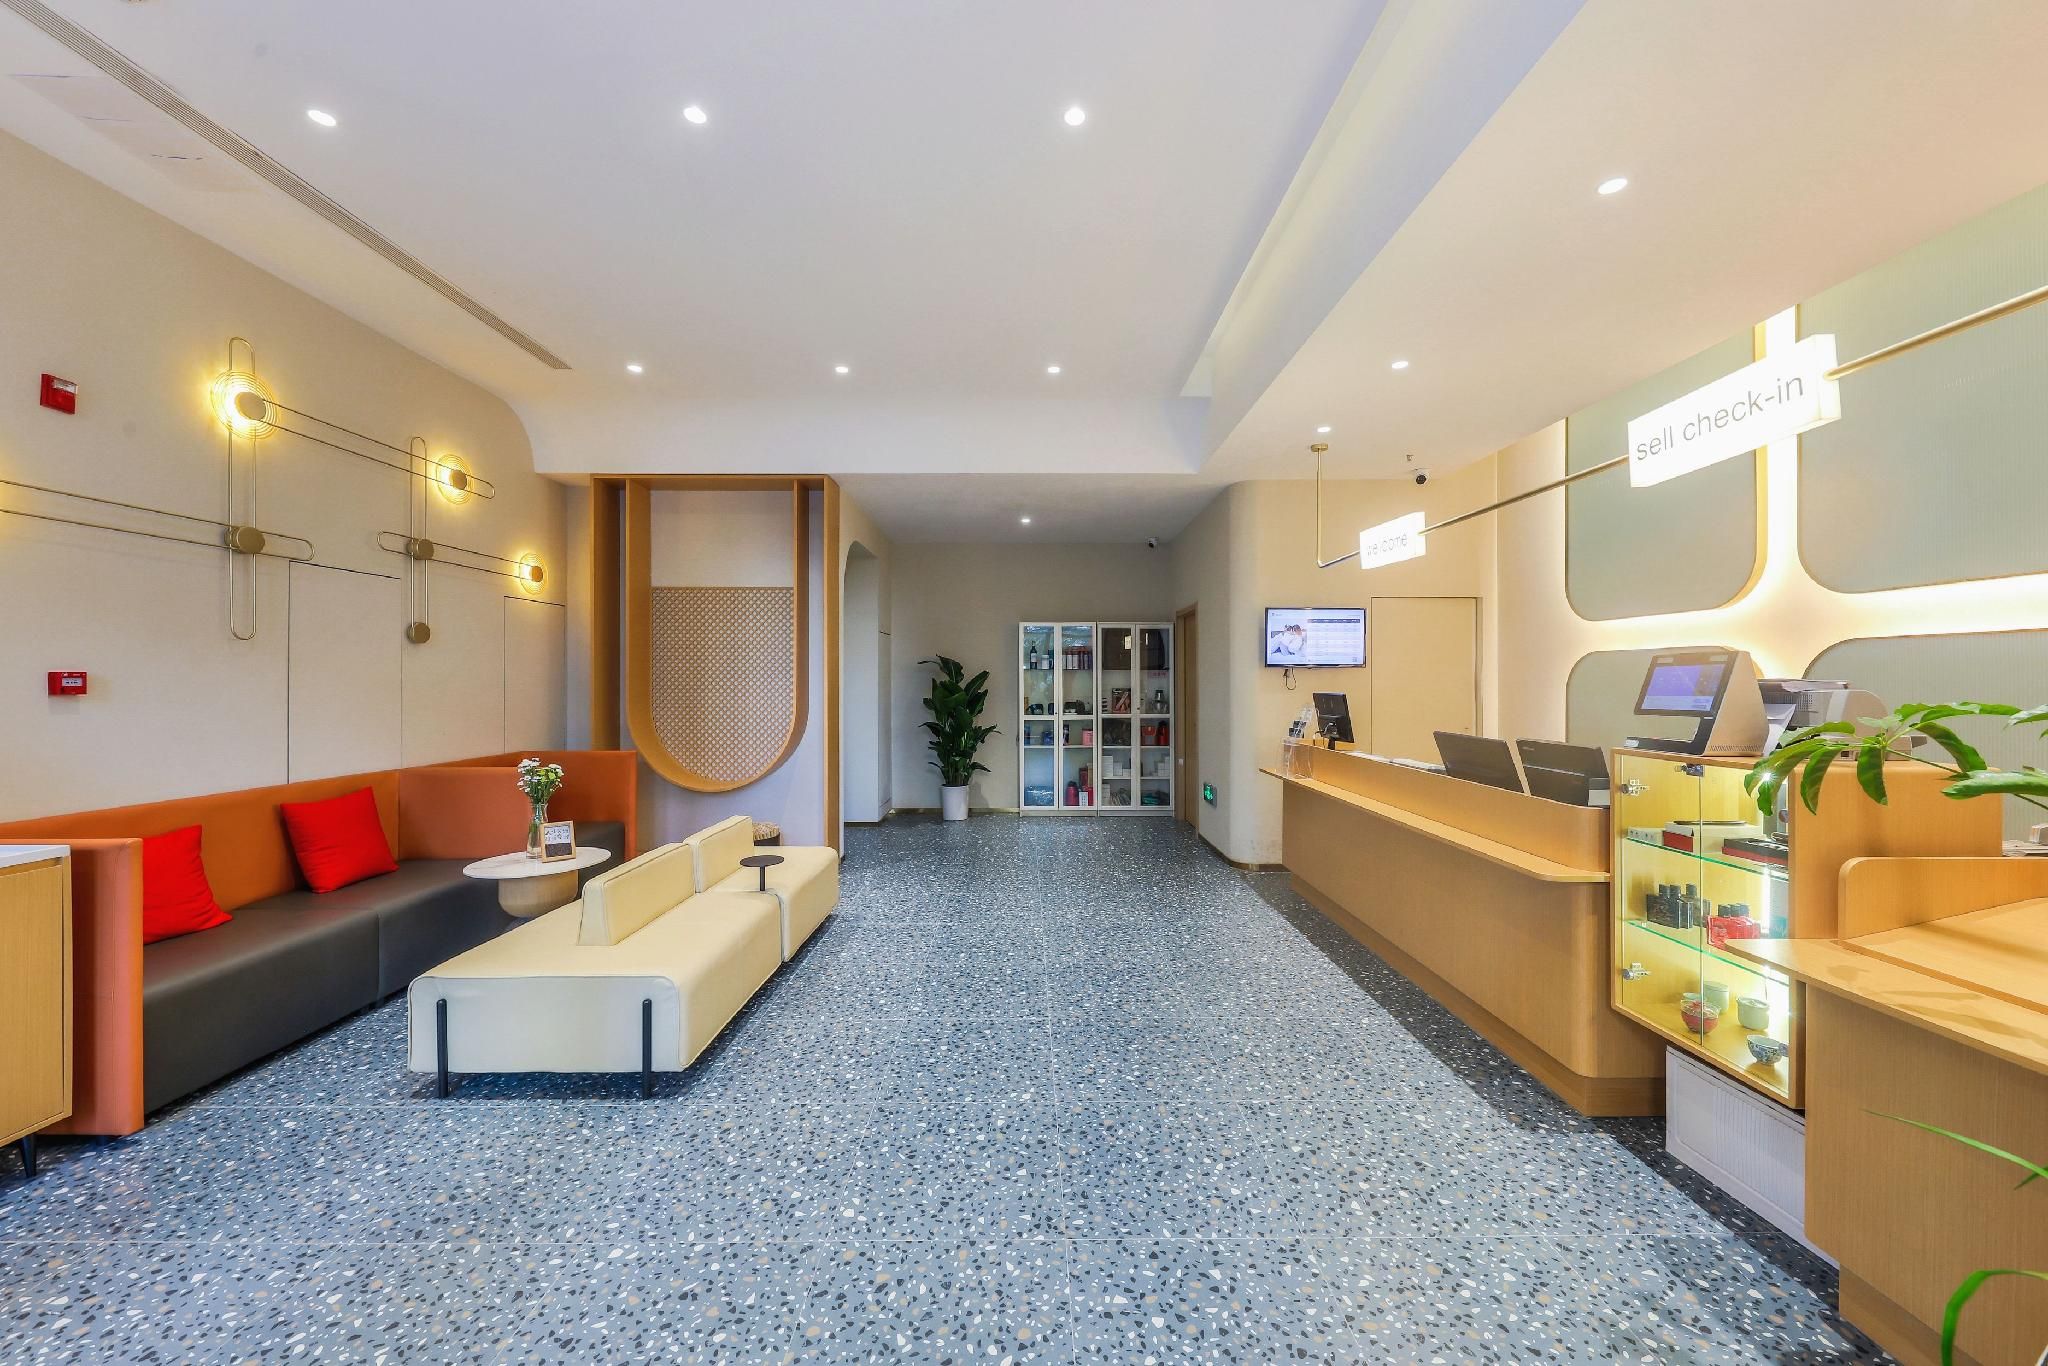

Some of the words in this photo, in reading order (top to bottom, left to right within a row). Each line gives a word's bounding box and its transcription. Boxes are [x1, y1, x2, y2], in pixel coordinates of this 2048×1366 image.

[1637, 425, 1674, 461] sell
[1683, 377, 1804, 441] check-in
[1367, 533, 1408, 556] ecome
